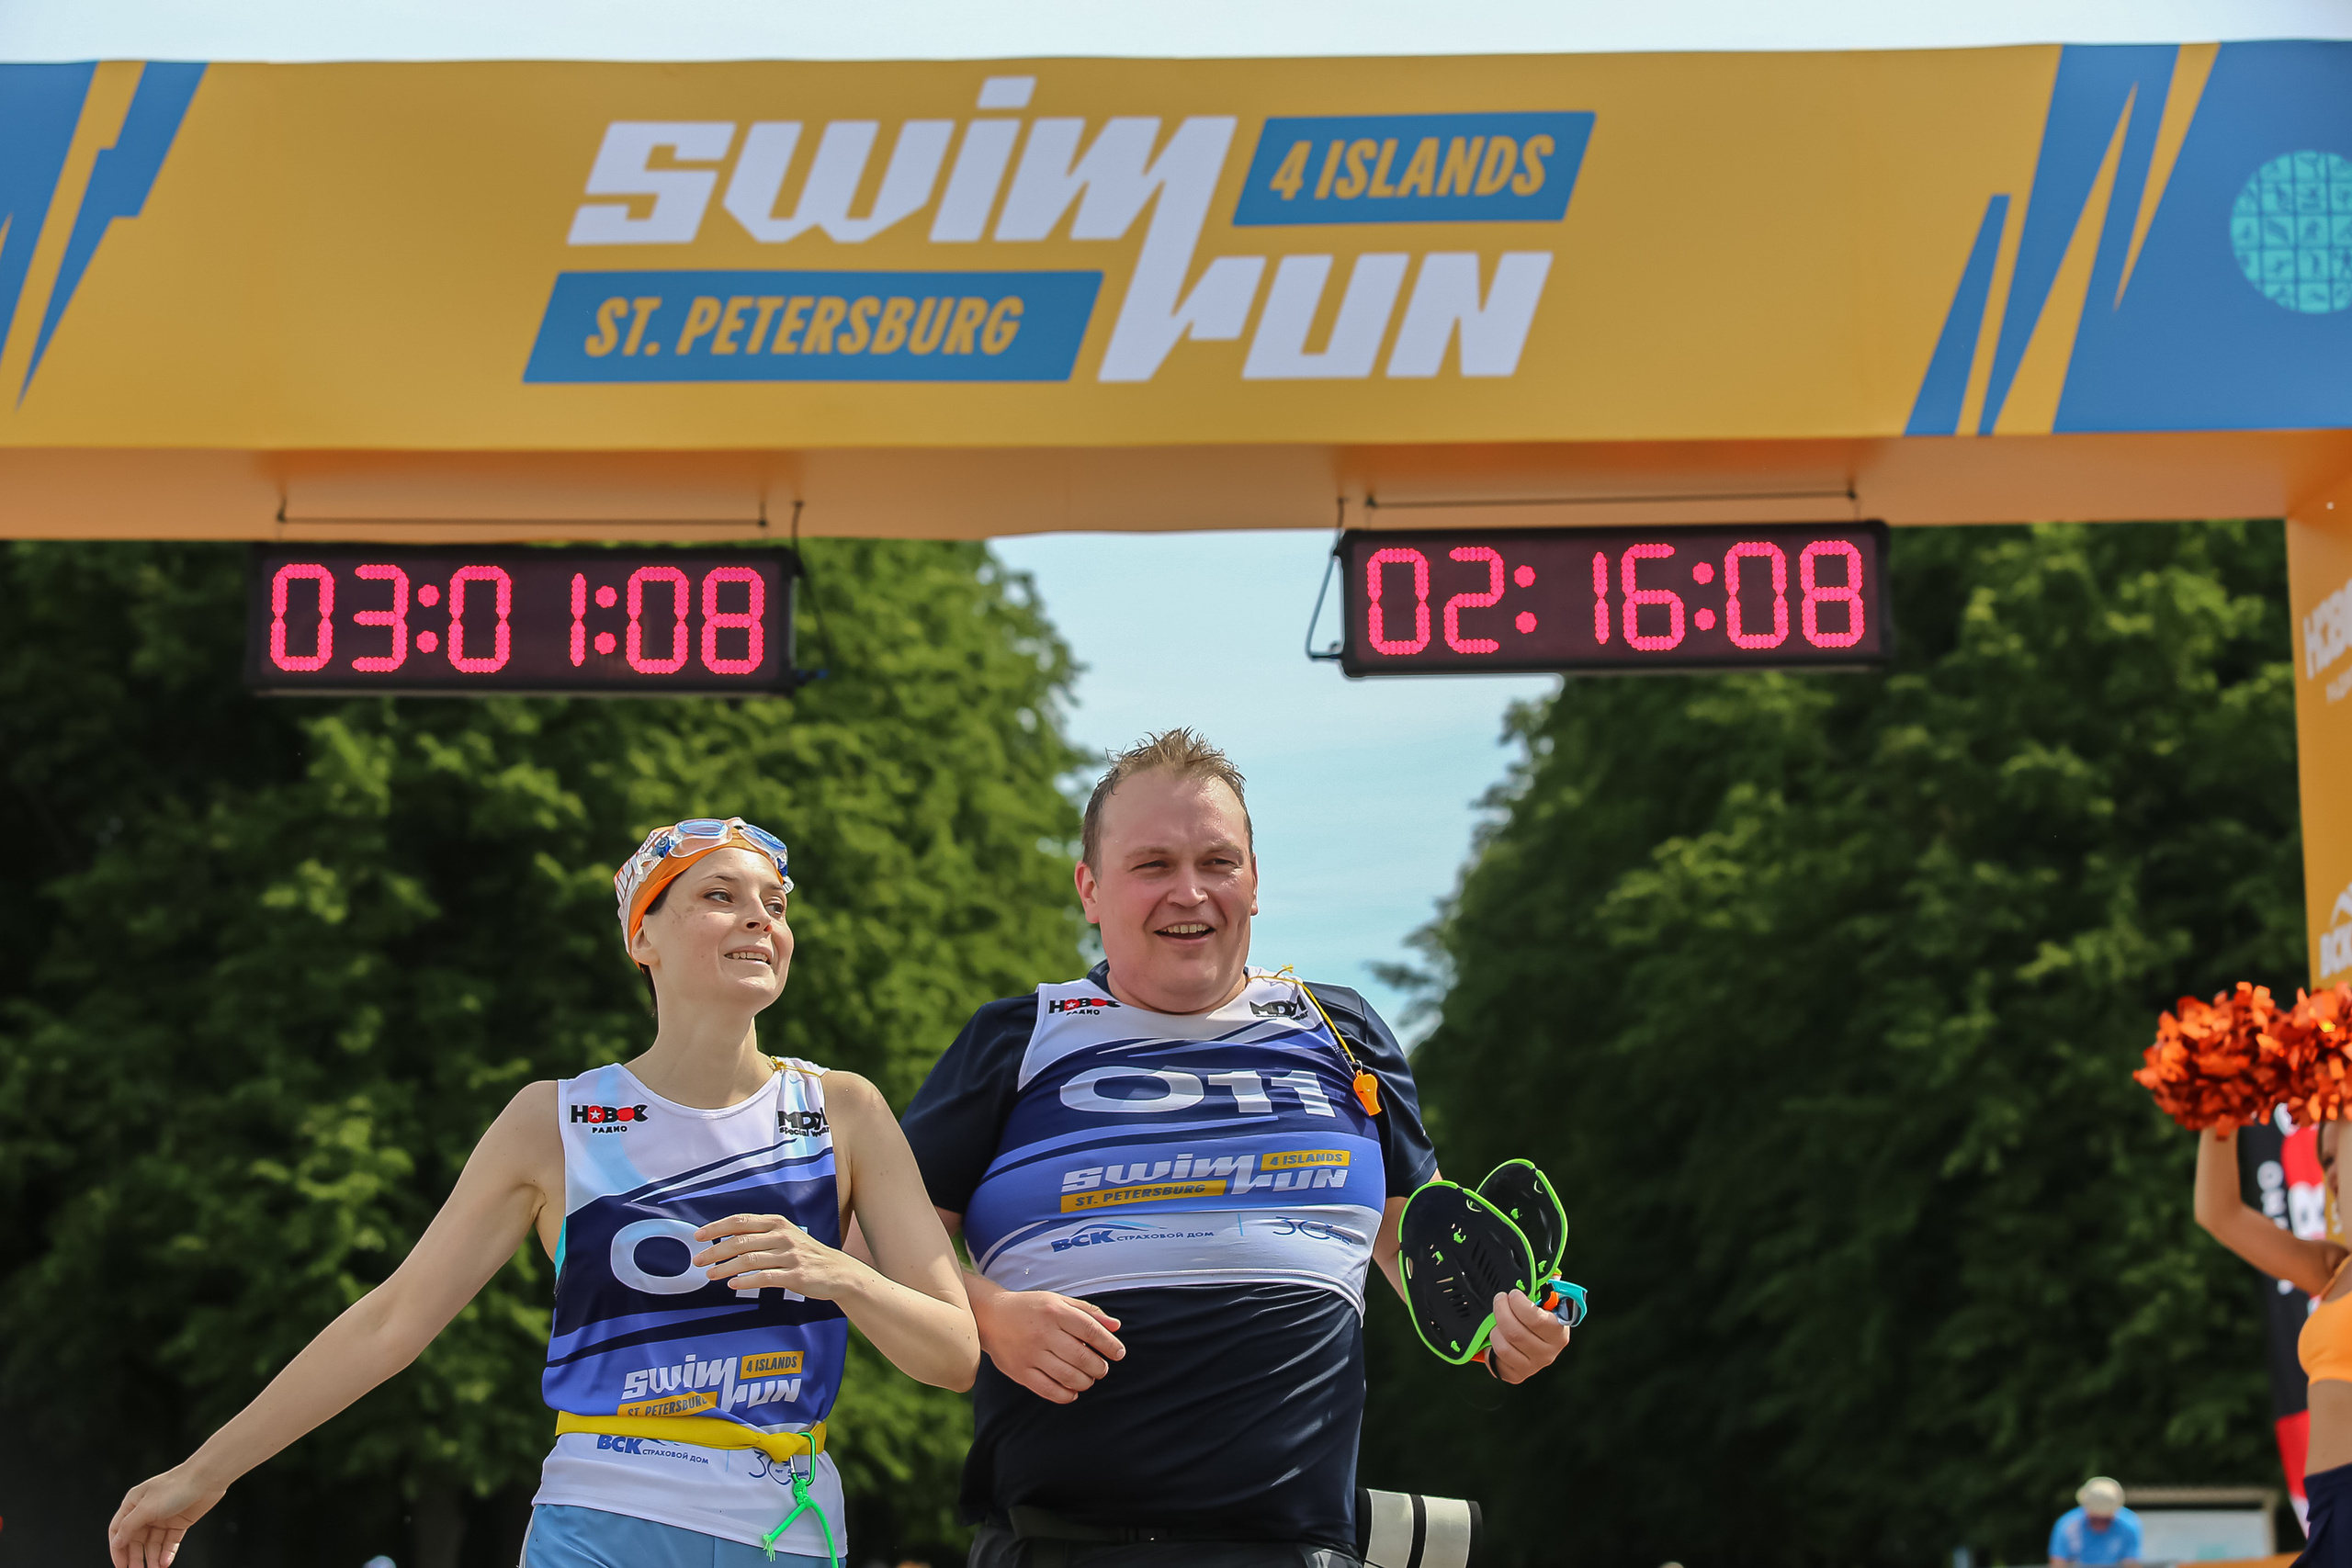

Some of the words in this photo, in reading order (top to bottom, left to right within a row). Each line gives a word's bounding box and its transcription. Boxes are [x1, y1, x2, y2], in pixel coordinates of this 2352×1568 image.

[1269, 140, 1313, 200] 4
[1314, 134, 1555, 200] ISLANDS
[584, 295, 662, 357] ST.
[675, 295, 1025, 356] PETERSBURG
[1059, 1066, 1336, 1118] 011
[592, 1125, 628, 1134] РАДИО
[1270, 1156, 1279, 1166] 4
[1283, 1153, 1343, 1166] ISLANDS
[1075, 1195, 1099, 1207] ST.
[1102, 1184, 1206, 1202] PETERSBURG
[1116, 1232, 1183, 1242] СТРАХОВОЙ
[746, 1359, 752, 1372] 4
[754, 1356, 797, 1372] ISLANDS
[628, 1407, 640, 1416] ST
[597, 1434, 643, 1455] ВСК
[643, 1449, 688, 1460] СТРАХОВОЙ
[689, 1455, 708, 1464] ДОМ
